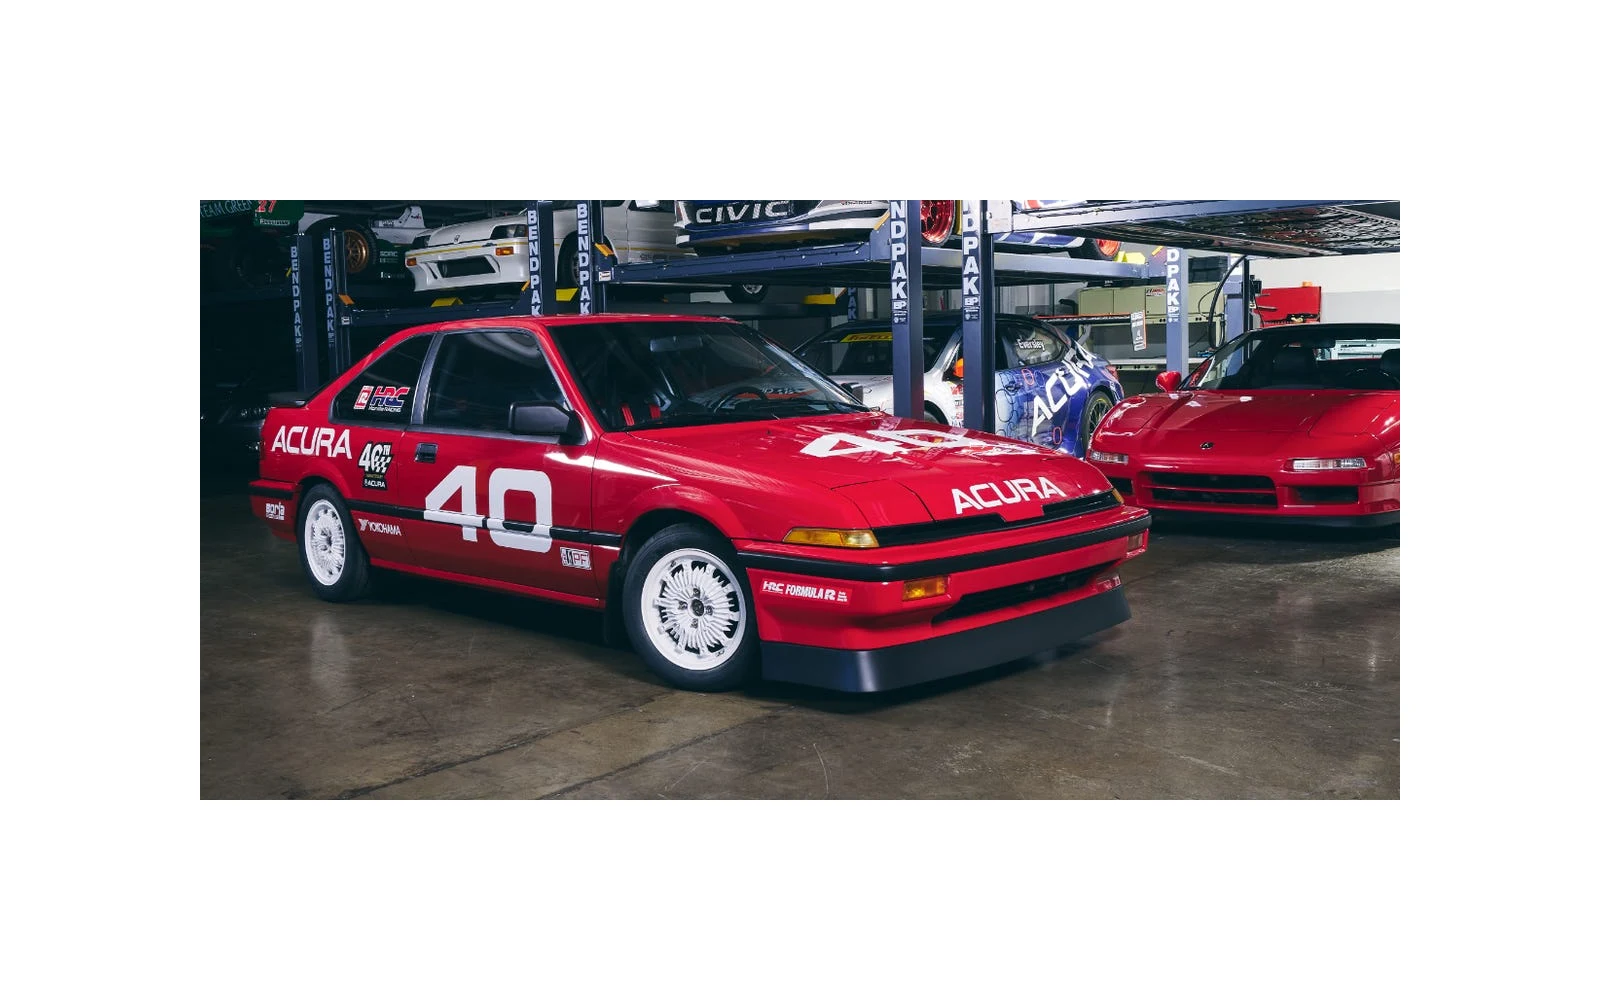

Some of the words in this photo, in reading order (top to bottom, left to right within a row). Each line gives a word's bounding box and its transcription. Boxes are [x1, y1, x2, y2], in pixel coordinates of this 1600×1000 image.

[696, 200, 788, 223] CIVIC
[271, 425, 352, 459] ACURA
[423, 465, 553, 553] 40
[951, 476, 1067, 515] ACURA
[368, 521, 402, 536] YOKOHAMA
[762, 580, 785, 593] HRC
[785, 584, 824, 599] FORMULA
